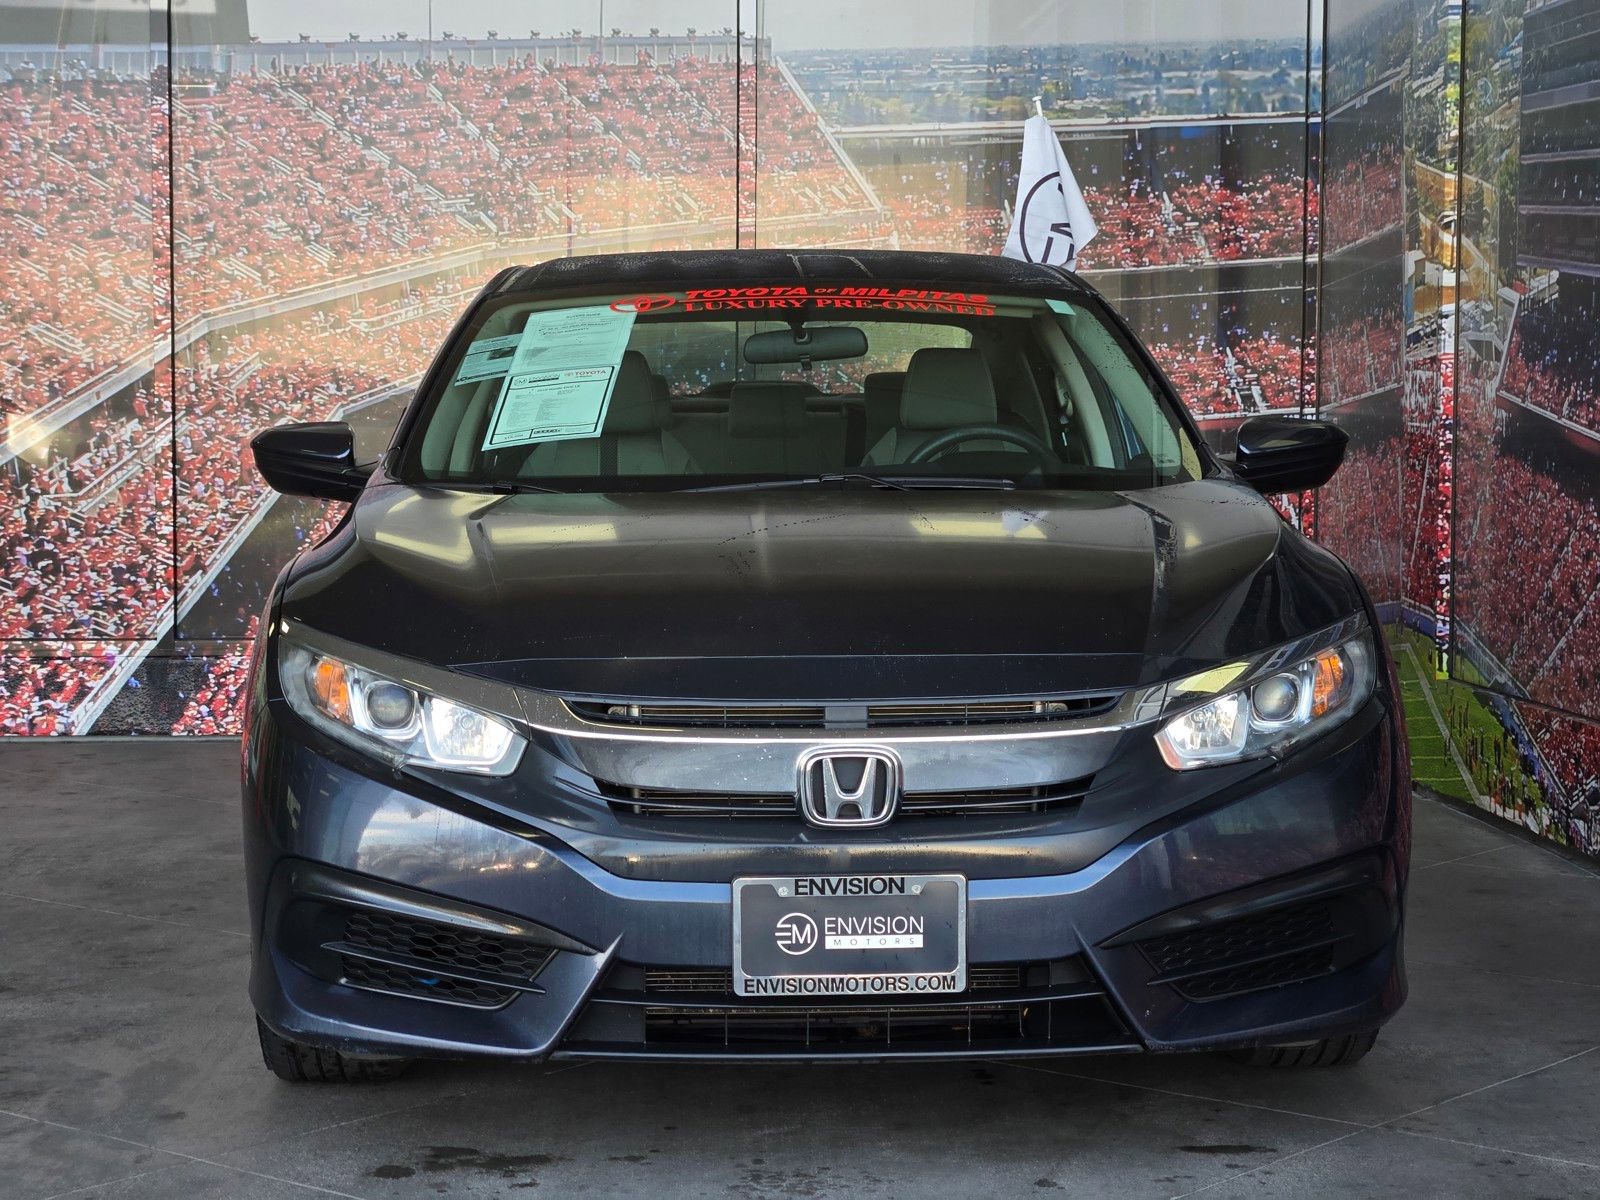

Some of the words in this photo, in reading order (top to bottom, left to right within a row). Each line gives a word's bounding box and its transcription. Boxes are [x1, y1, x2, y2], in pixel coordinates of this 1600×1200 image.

[685, 287, 808, 299] TOYOTA
[840, 287, 988, 303] MILPITAS
[685, 299, 807, 312] LUXURY
[816, 299, 995, 316] PRE-OWNED
[794, 877, 905, 896] ENVISION
[824, 916, 924, 935] ENVISION
[833, 937, 915, 946] MOTORS
[743, 975, 956, 994] ENVISIONMOTORS.COM
